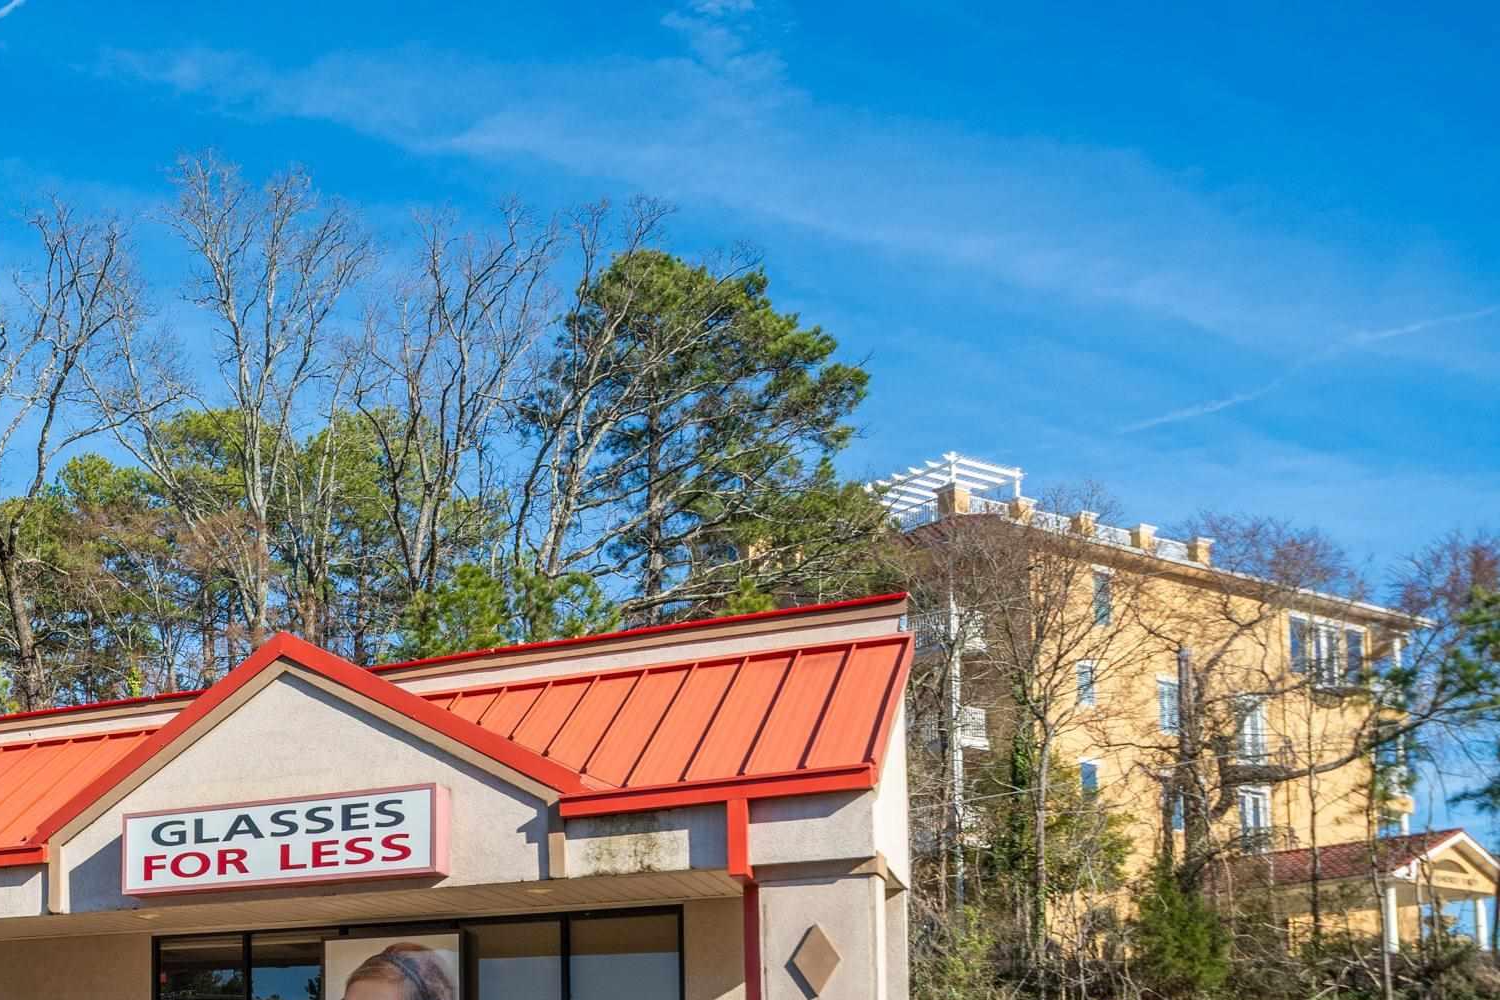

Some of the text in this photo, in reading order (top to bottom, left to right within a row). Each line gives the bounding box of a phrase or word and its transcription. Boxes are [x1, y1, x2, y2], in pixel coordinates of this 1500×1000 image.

[151, 799, 405, 847] GLASSES
[143, 833, 412, 881] FOR LESS
